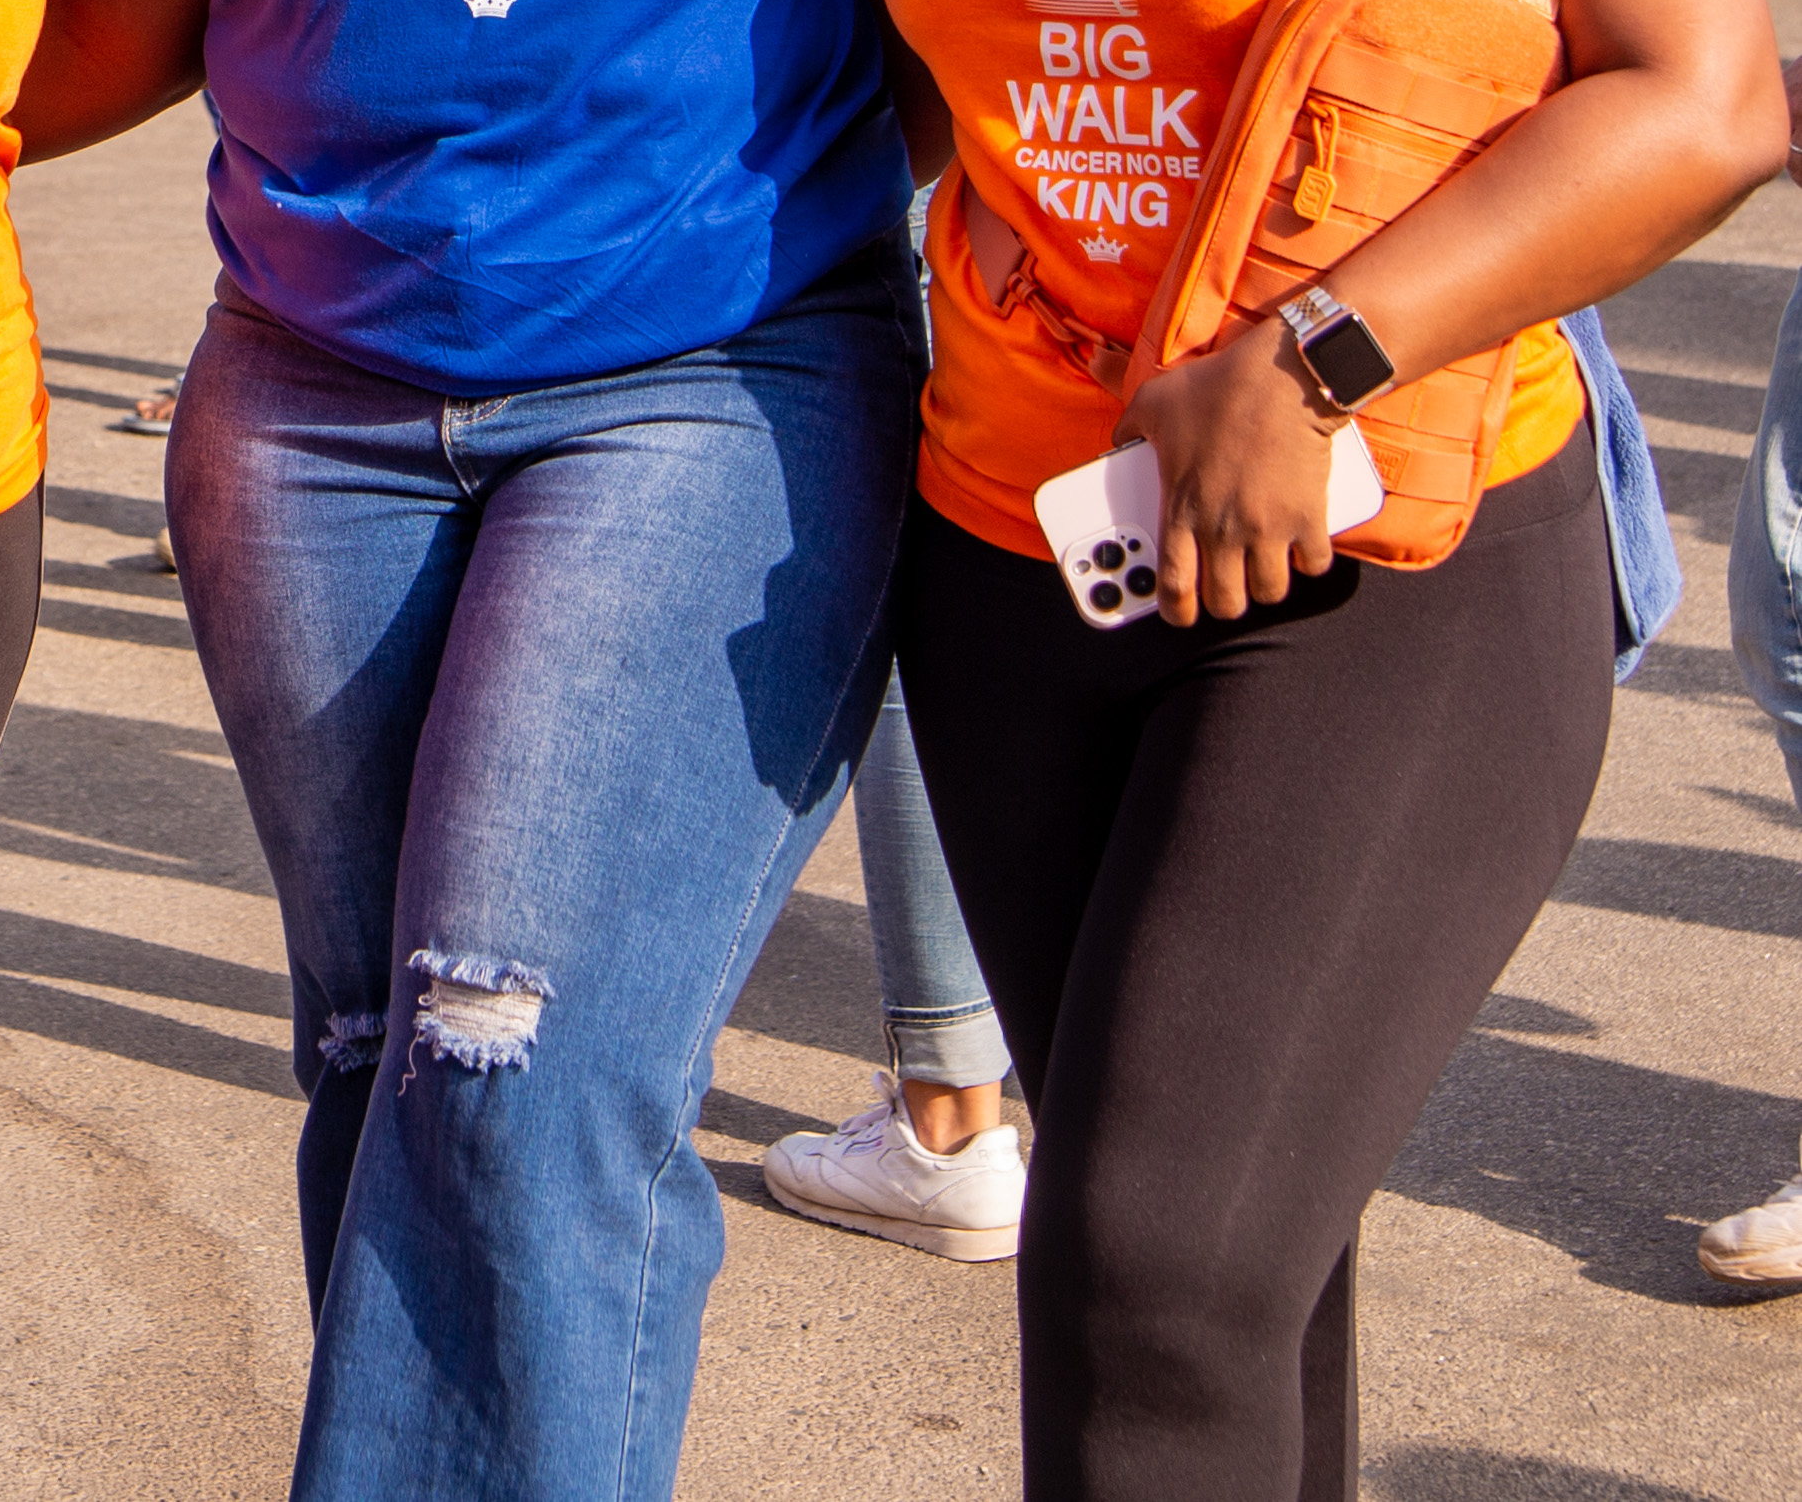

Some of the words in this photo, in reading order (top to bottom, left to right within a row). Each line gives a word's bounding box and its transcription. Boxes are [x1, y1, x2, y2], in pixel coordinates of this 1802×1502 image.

[1040, 22, 1151, 80] BIG
[1007, 81, 1199, 149] WALK
[1016, 148, 1122, 174] CANCER
[1128, 154, 1162, 176] NO
[1165, 158, 1199, 178] BE
[1039, 177, 1169, 227] KING
